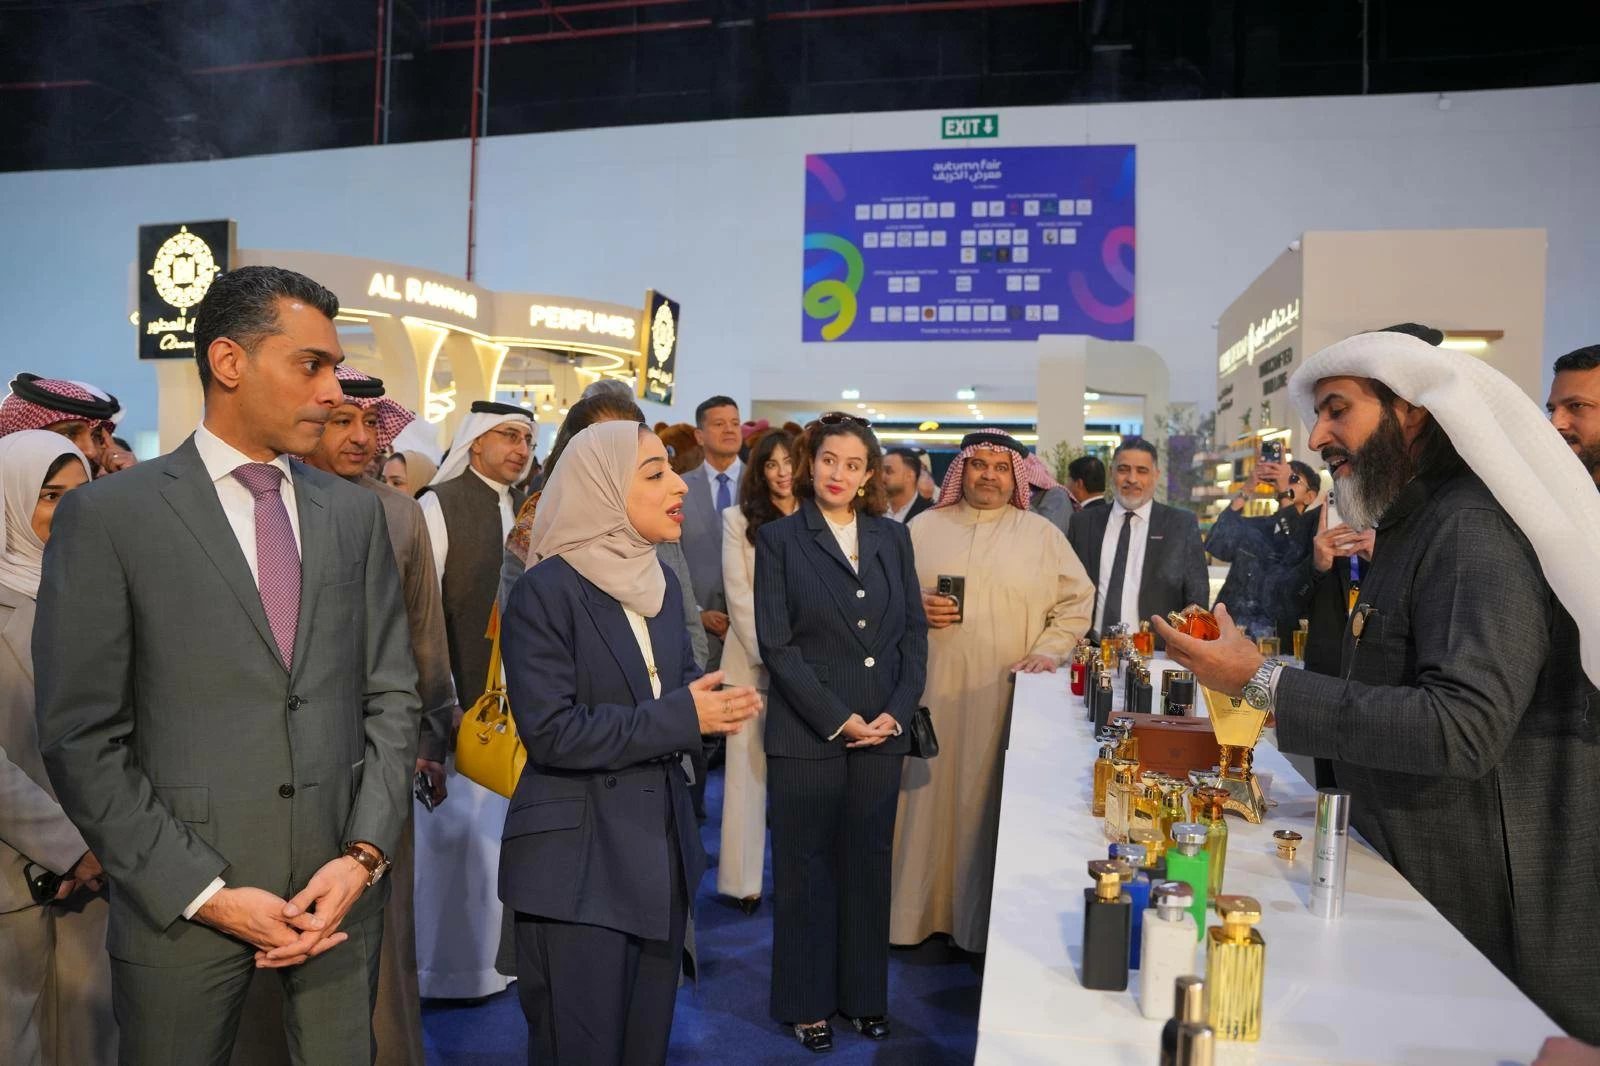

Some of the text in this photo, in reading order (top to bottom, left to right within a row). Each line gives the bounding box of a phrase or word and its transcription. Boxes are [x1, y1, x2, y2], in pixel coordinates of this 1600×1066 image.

[944, 118, 981, 136] EXIT
[932, 158, 1002, 172] autumn fair
[367, 272, 402, 300] AL
[529, 304, 636, 340] PERFUMES
